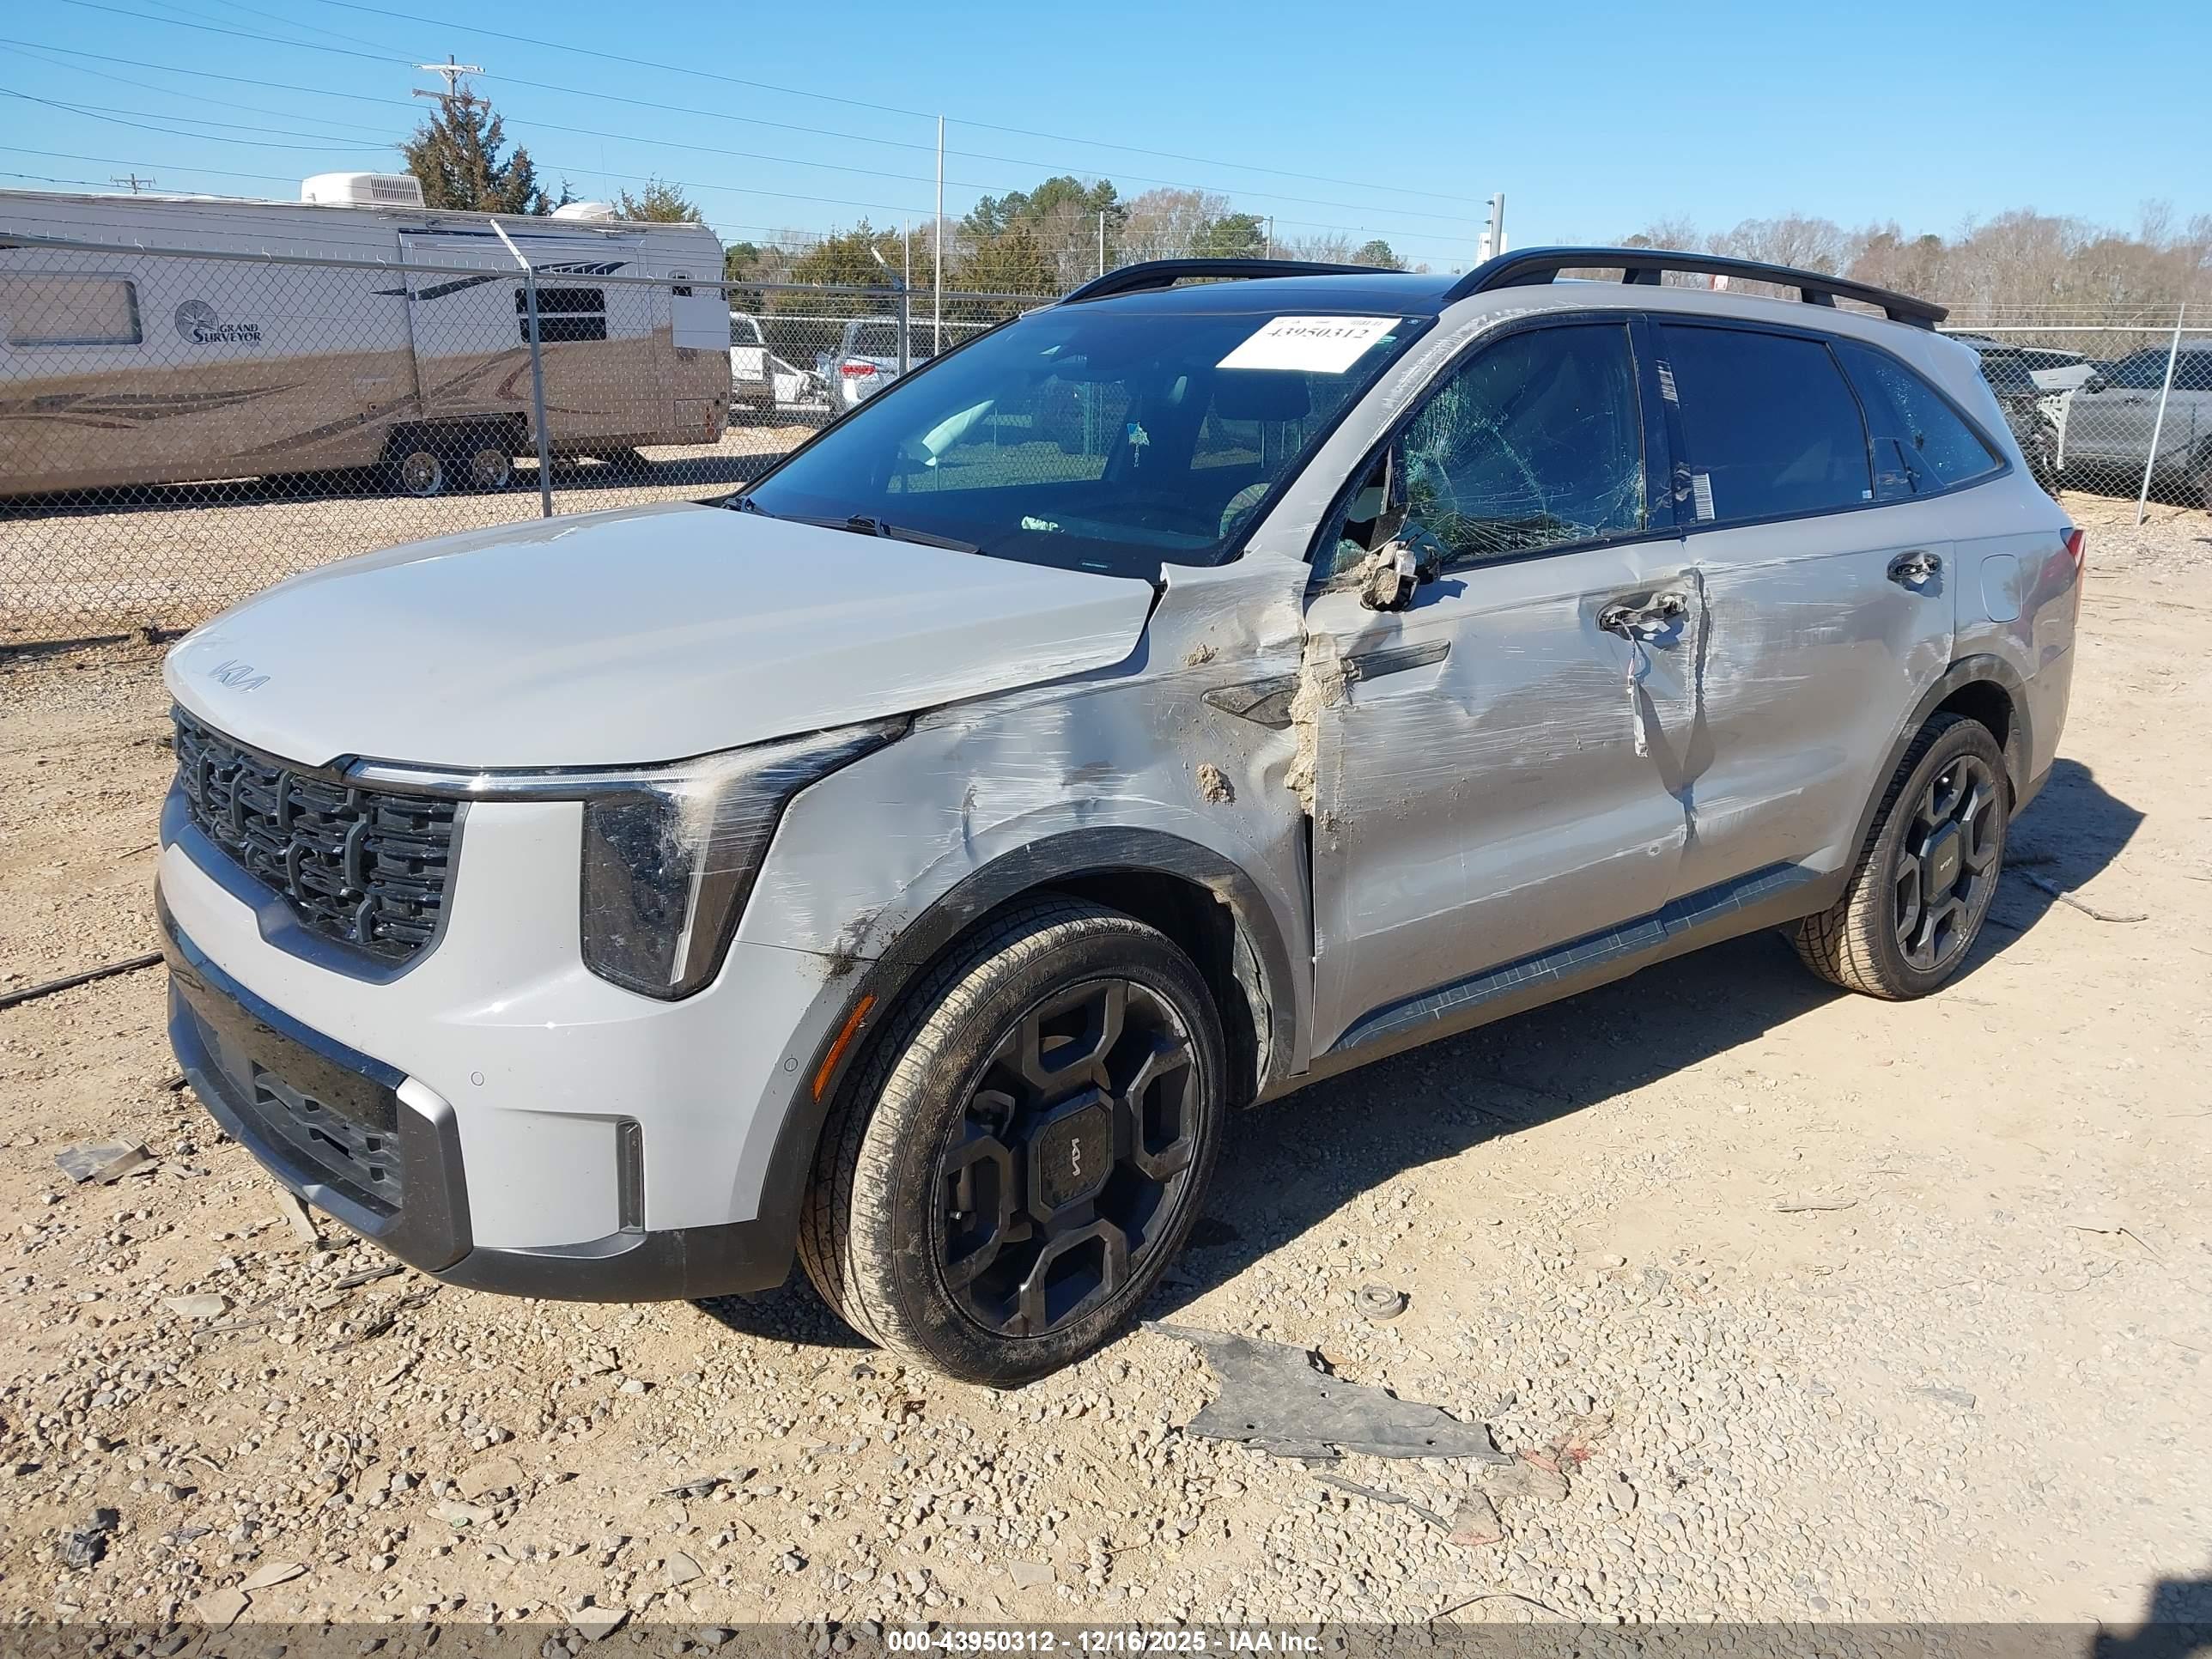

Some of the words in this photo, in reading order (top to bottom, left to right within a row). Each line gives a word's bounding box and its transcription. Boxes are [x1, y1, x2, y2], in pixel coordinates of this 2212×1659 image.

[220, 324, 258, 332] GRAND
[1267, 328, 1370, 338] 43950312
[193, 328, 262, 343] SURVEYOR
